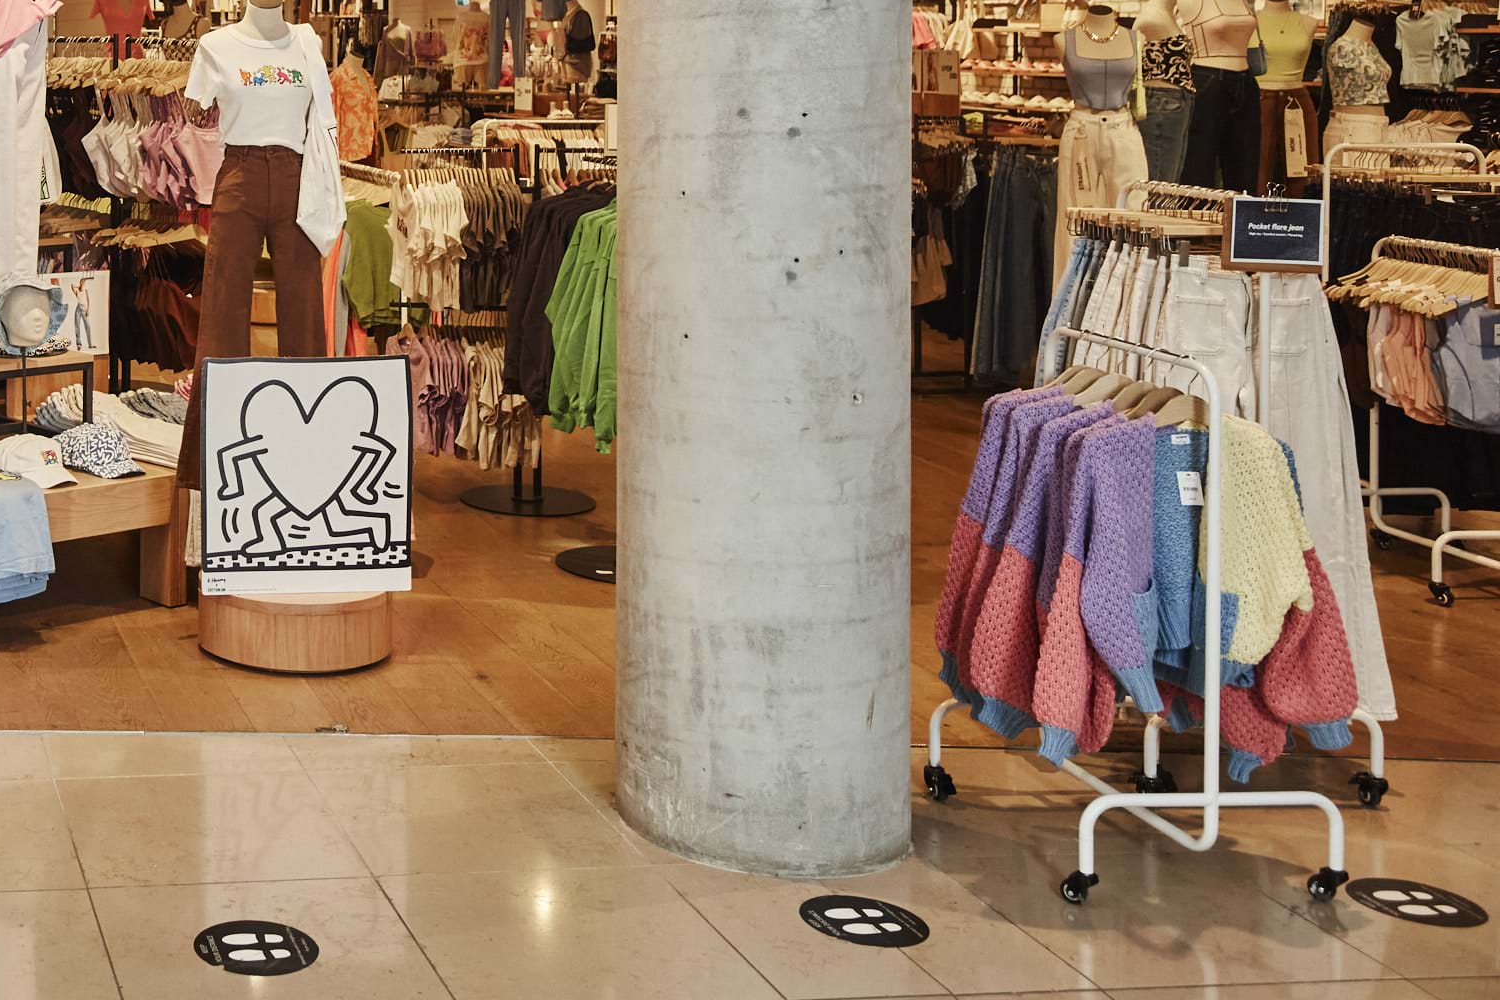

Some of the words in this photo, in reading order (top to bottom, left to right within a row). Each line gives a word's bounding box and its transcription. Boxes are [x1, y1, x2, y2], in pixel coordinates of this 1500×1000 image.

[1248, 222, 1271, 230] Pocket
[1272, 223, 1288, 231] flare
[1288, 224, 1304, 232] jean
